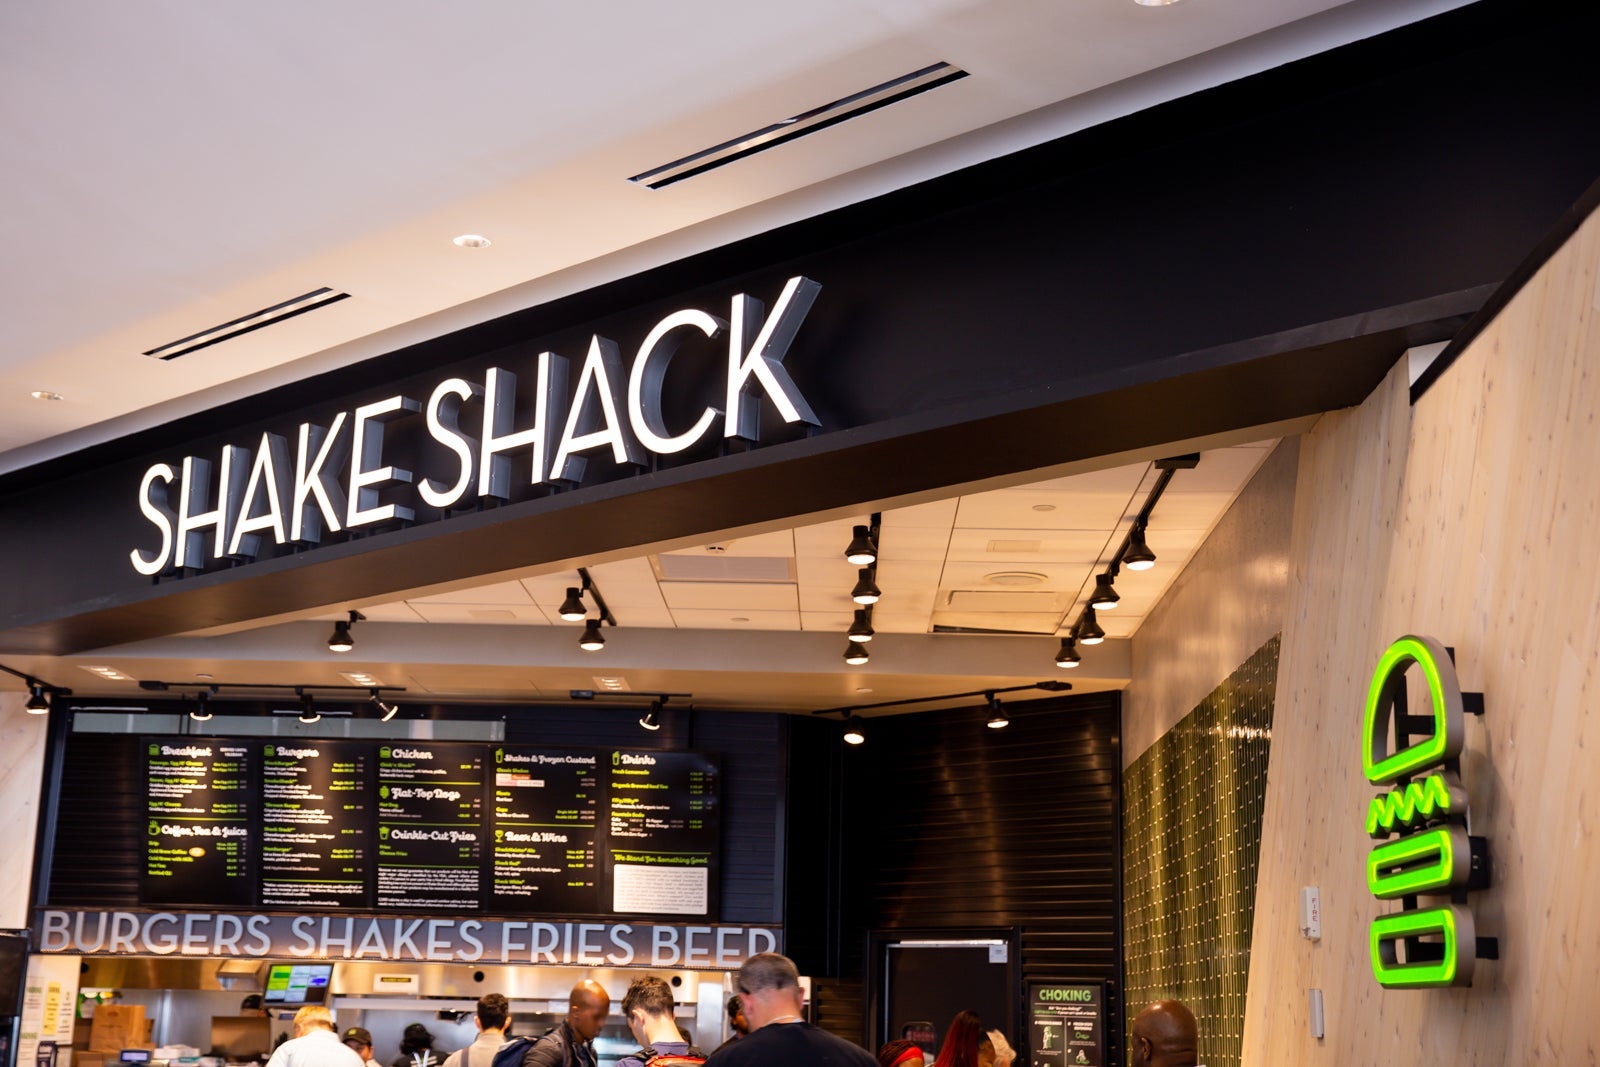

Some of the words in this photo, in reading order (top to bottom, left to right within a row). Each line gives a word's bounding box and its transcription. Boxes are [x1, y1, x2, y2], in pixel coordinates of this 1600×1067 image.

[130, 395, 404, 576] SHAKE
[417, 275, 806, 508] SHACK
[161, 746, 212, 758] Breakfast
[276, 746, 320, 759] Burgers
[392, 749, 433, 760] Chicken
[504, 754, 530, 762] Shakes
[538, 755, 565, 765] Frozen
[566, 756, 596, 764] Custard
[621, 754, 656, 765] Drinks
[390, 787, 434, 800] Flat-Top
[434, 788, 460, 801] Dogs
[212, 826, 222, 836] &
[222, 827, 248, 838] Juice
[391, 829, 449, 840] Crinkle-Cut
[449, 831, 476, 843] Fries
[505, 831, 531, 842] Beer
[531, 832, 540, 842] &
[540, 832, 568, 842] Wine
[40, 910, 271, 957] BURGERS
[288, 915, 485, 962] SHAKES
[500, 921, 634, 966] FRIES
[1039, 989, 1092, 1002] CHOKING
